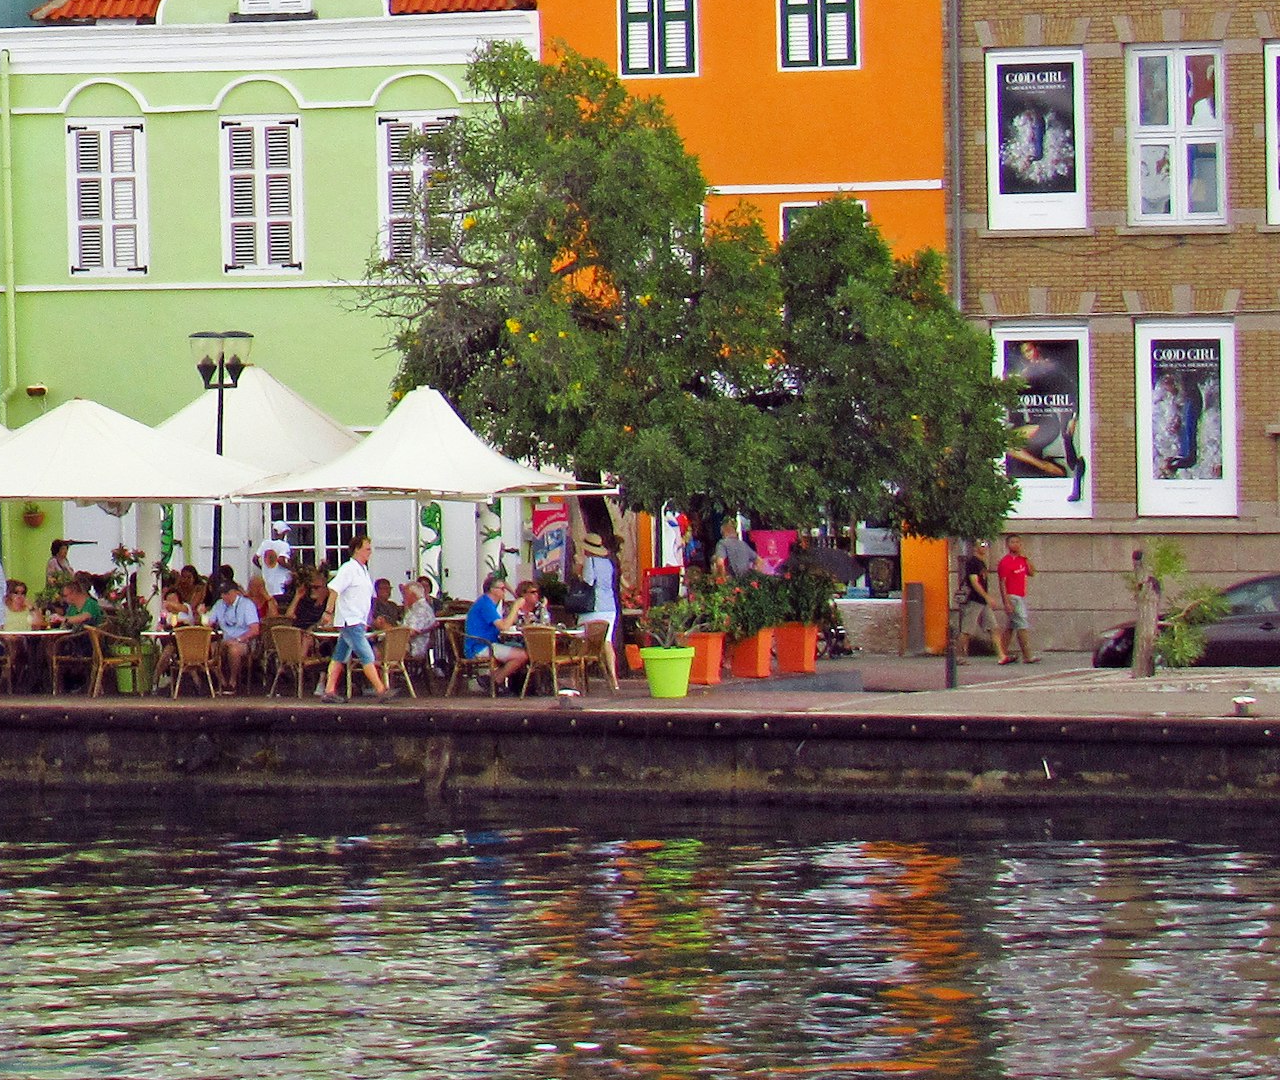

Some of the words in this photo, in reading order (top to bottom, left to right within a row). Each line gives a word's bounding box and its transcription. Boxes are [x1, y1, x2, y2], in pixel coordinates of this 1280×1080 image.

[1005, 72, 1036, 84] GOOD
[1037, 71, 1066, 83] GIRL
[1153, 349, 1186, 362] GOOD
[1187, 348, 1219, 361] GIRL
[1018, 394, 1042, 407] OOD
[1043, 393, 1074, 406] GIRL
